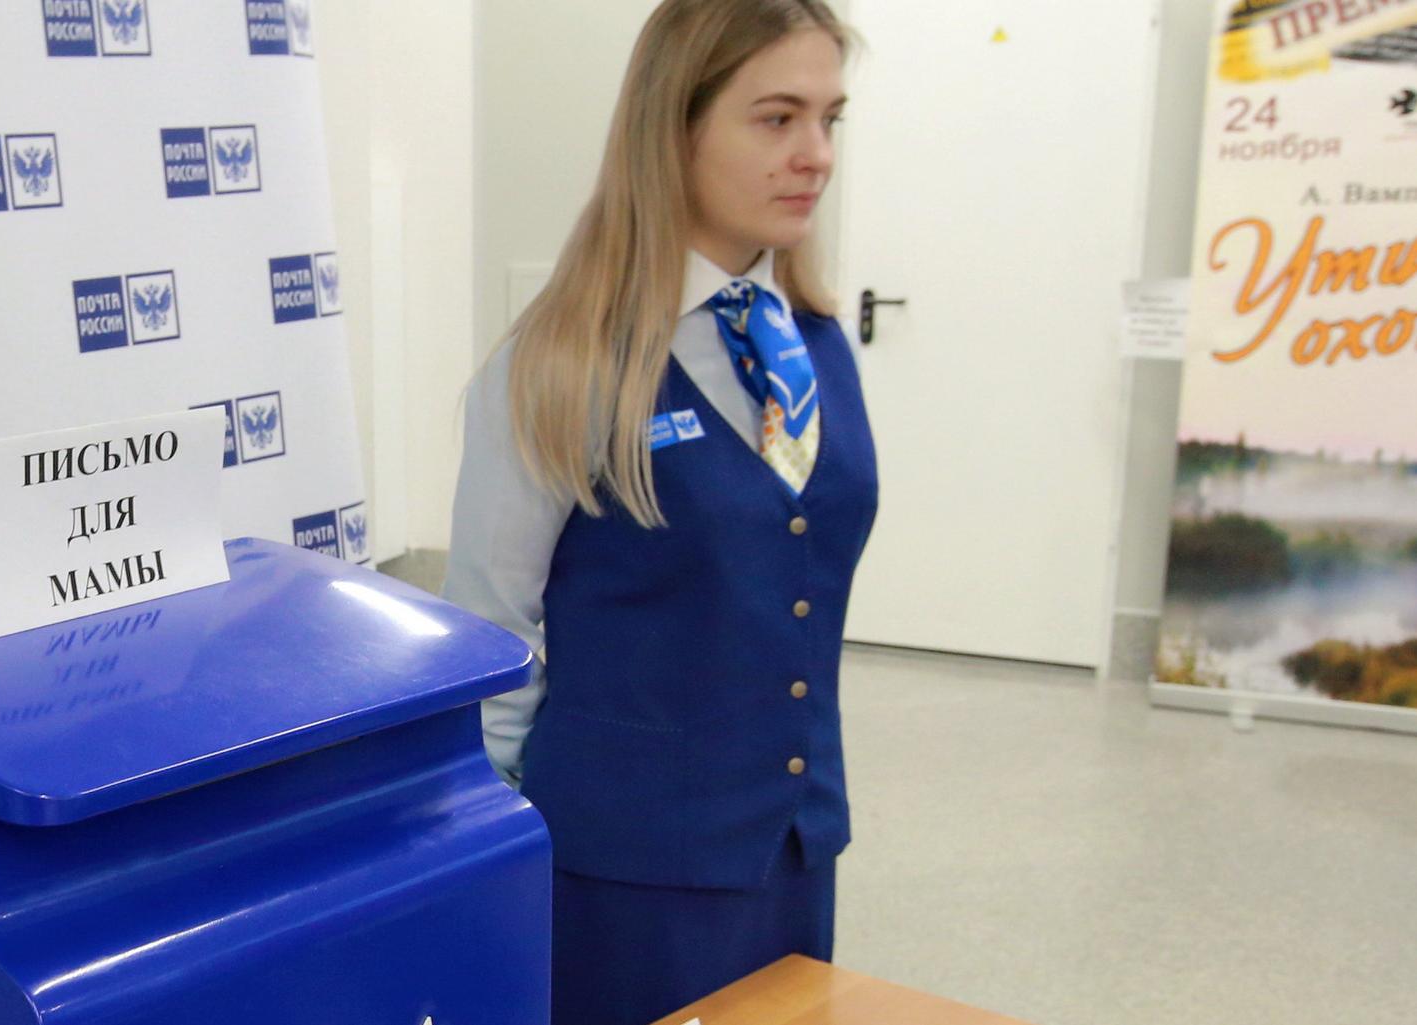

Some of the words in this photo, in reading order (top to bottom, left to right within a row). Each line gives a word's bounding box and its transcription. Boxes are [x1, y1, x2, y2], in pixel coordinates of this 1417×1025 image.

[1224, 96, 1278, 132] 24
[1219, 132, 1341, 164] ноября
[77, 292, 121, 315] ПОЧТА
[80, 315, 124, 336] РОССИИ
[21, 430, 179, 488] ПИСЬМО
[67, 495, 138, 549] ДЛЯ
[47, 549, 167, 608] МАМЫ
